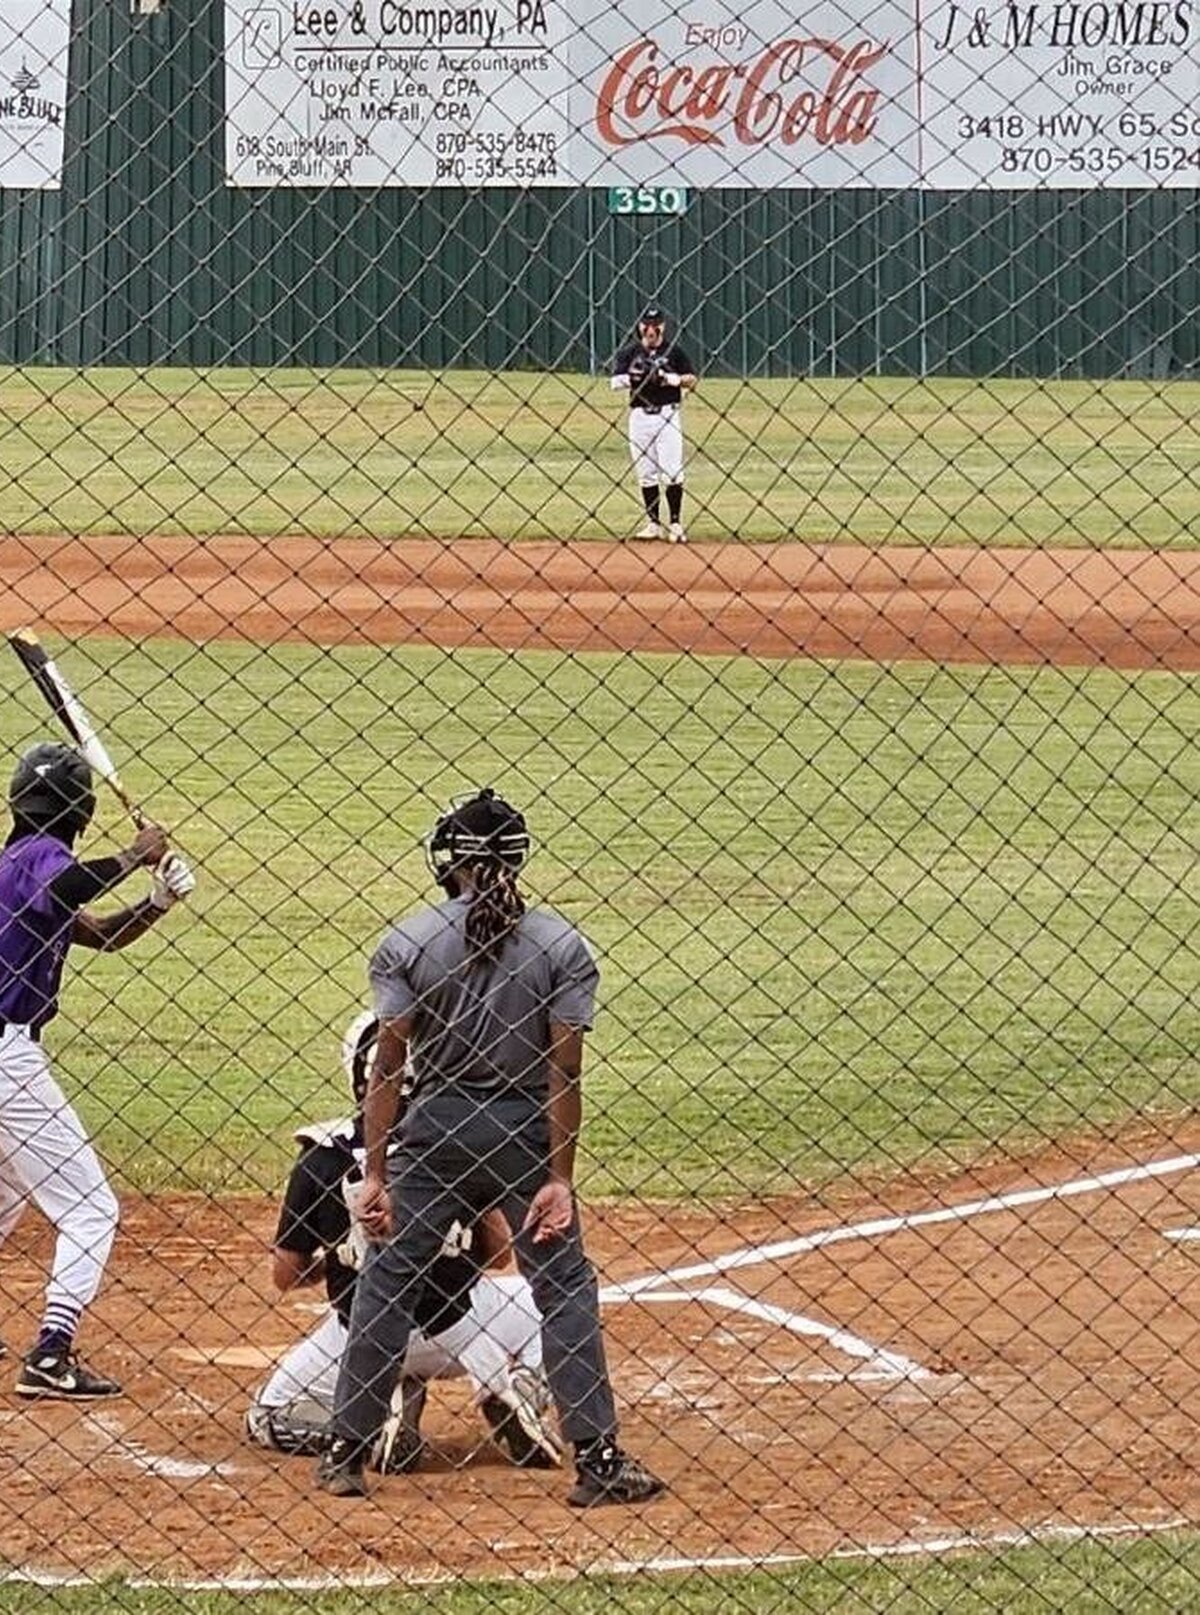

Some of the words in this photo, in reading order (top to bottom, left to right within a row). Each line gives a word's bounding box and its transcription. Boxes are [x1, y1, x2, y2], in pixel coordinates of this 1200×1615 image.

[293, 1, 338, 35] Lee
[349, 2, 367, 35] &
[380, 2, 505, 42] Company,
[517, 2, 548, 34] PA
[934, 5, 959, 50] J
[967, 7, 991, 48] &
[1002, 3, 1039, 49] M
[1050, 2, 1193, 48] HOMES
[684, 23, 751, 50] Enjoy
[294, 53, 370, 71] Certified
[376, 54, 429, 71] Public
[436, 54, 549, 71] Accountants
[1057, 56, 1093, 76] Jim
[1106, 55, 1173, 76] Grace
[309, 78, 359, 101] Lloyd
[442, 78, 481, 98] CPA
[1075, 80, 1134, 96] Owner
[319, 103, 351, 121] Jim
[360, 102, 425, 122] McFall,
[433, 102, 472, 121] CPA
[958, 115, 1023, 138] 3418
[266, 136, 308, 157] South
[314, 135, 348, 157] Main
[436, 132, 556, 153] 870-535-8476
[256, 160, 284, 176] Pine
[333, 160, 353, 177] AR
[436, 157, 557, 179] 870-535-5544
[615, 187, 681, 213] 350
